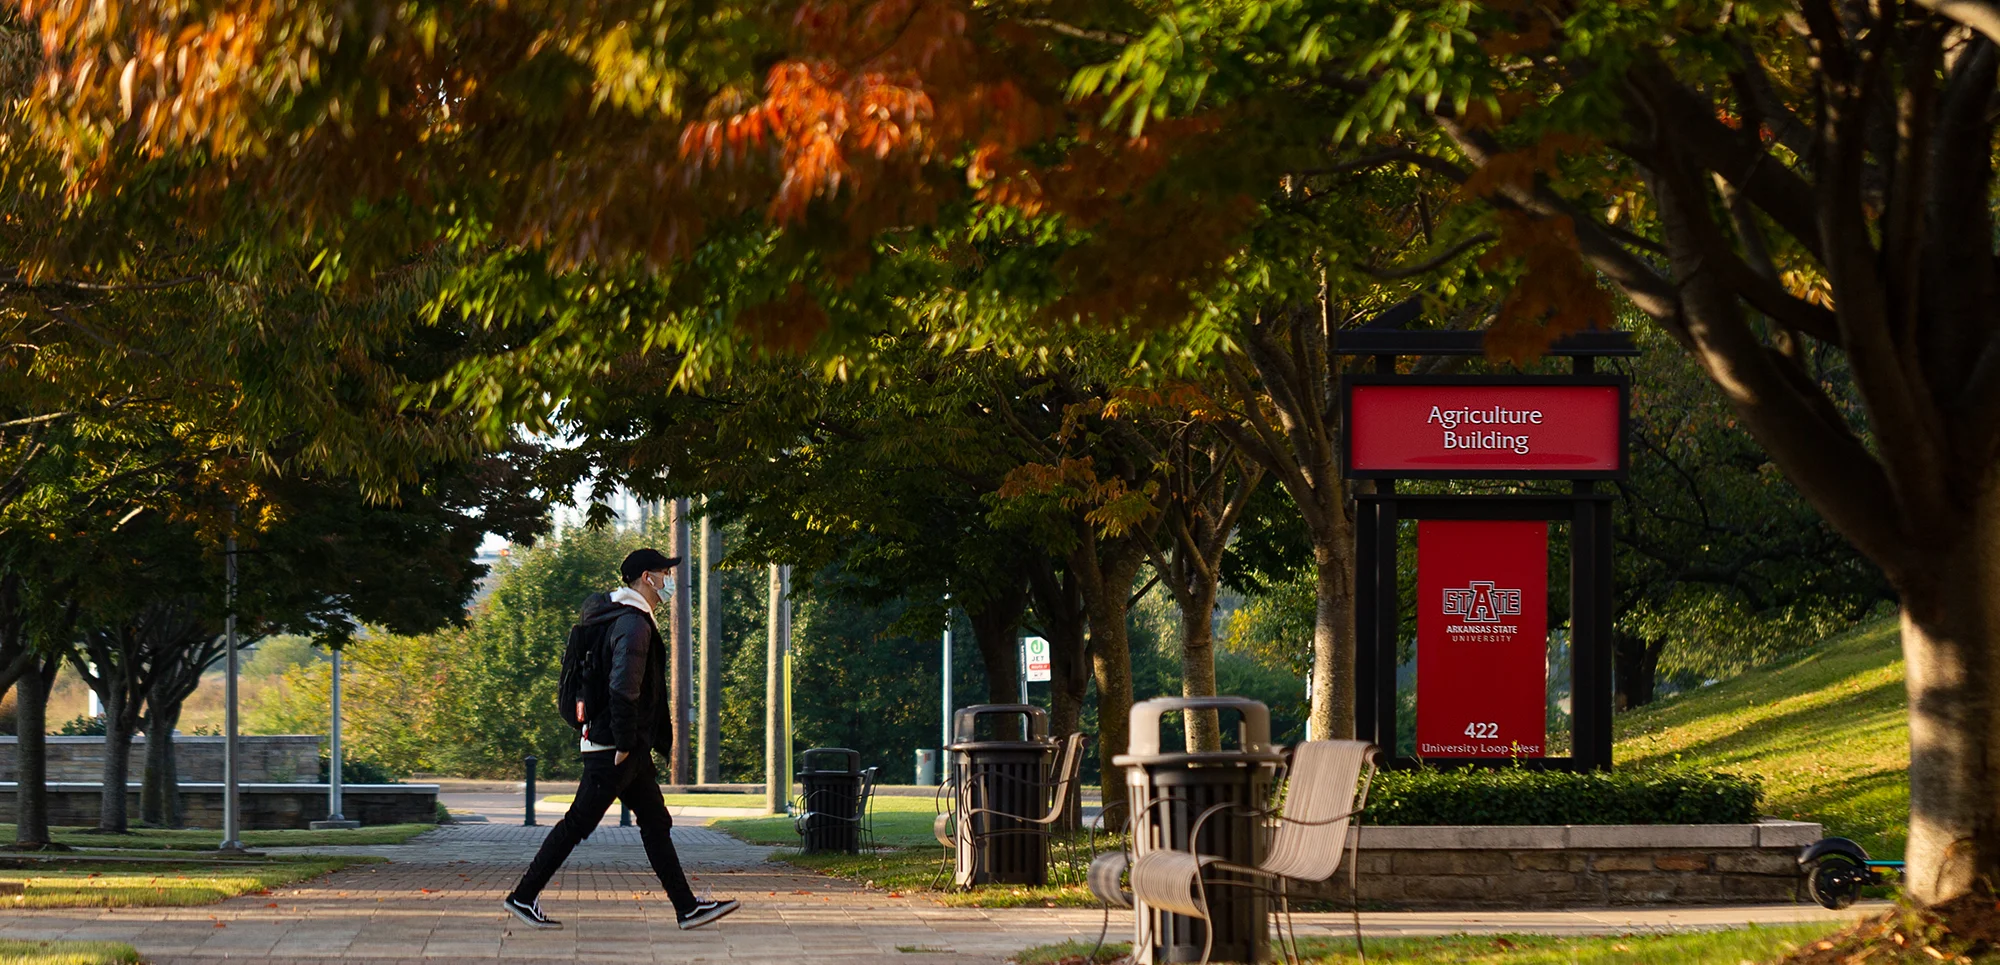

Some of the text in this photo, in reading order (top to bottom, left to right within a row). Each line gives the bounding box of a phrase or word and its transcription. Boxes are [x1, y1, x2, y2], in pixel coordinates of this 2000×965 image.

[1427, 406, 1543, 429] Agriculture
[1443, 431, 1530, 454] Building
[1443, 580, 1521, 623] STATE
[1446, 625, 1518, 634] ARKANSAS STATE
[1452, 635, 1512, 643] UNIVERSITY
[1464, 722, 1499, 739] 422
[1421, 743, 1478, 755] University
[1480, 743, 1509, 754] Loop
